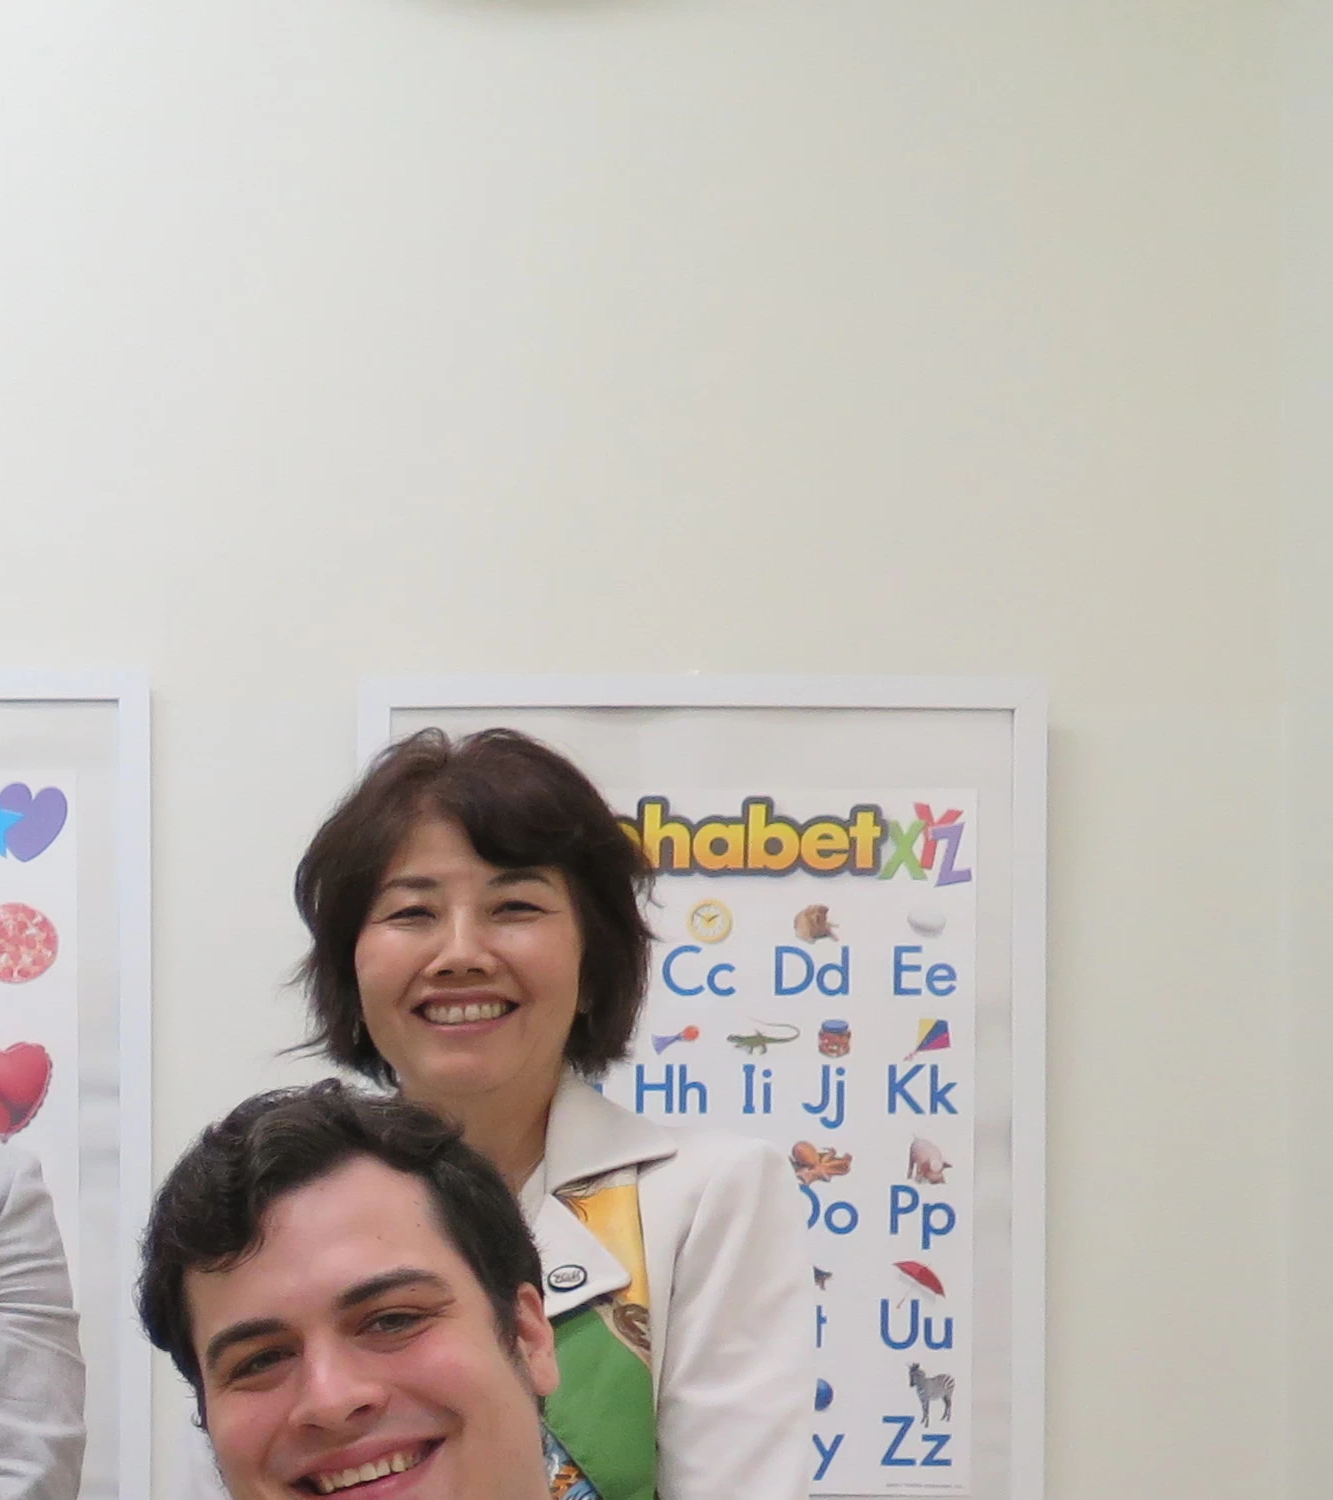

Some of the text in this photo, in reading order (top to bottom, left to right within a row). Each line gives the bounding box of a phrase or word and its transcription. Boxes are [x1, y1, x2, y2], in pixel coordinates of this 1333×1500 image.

[617, 798, 883, 874] habet
[662, 945, 958, 997] Cc Dd Ee
[635, 1064, 959, 1129] Hh Ii Jj Kk
[889, 1184, 957, 1250] Pp
[880, 1299, 954, 1350] Uu
[880, 1416, 953, 1467] Zz
